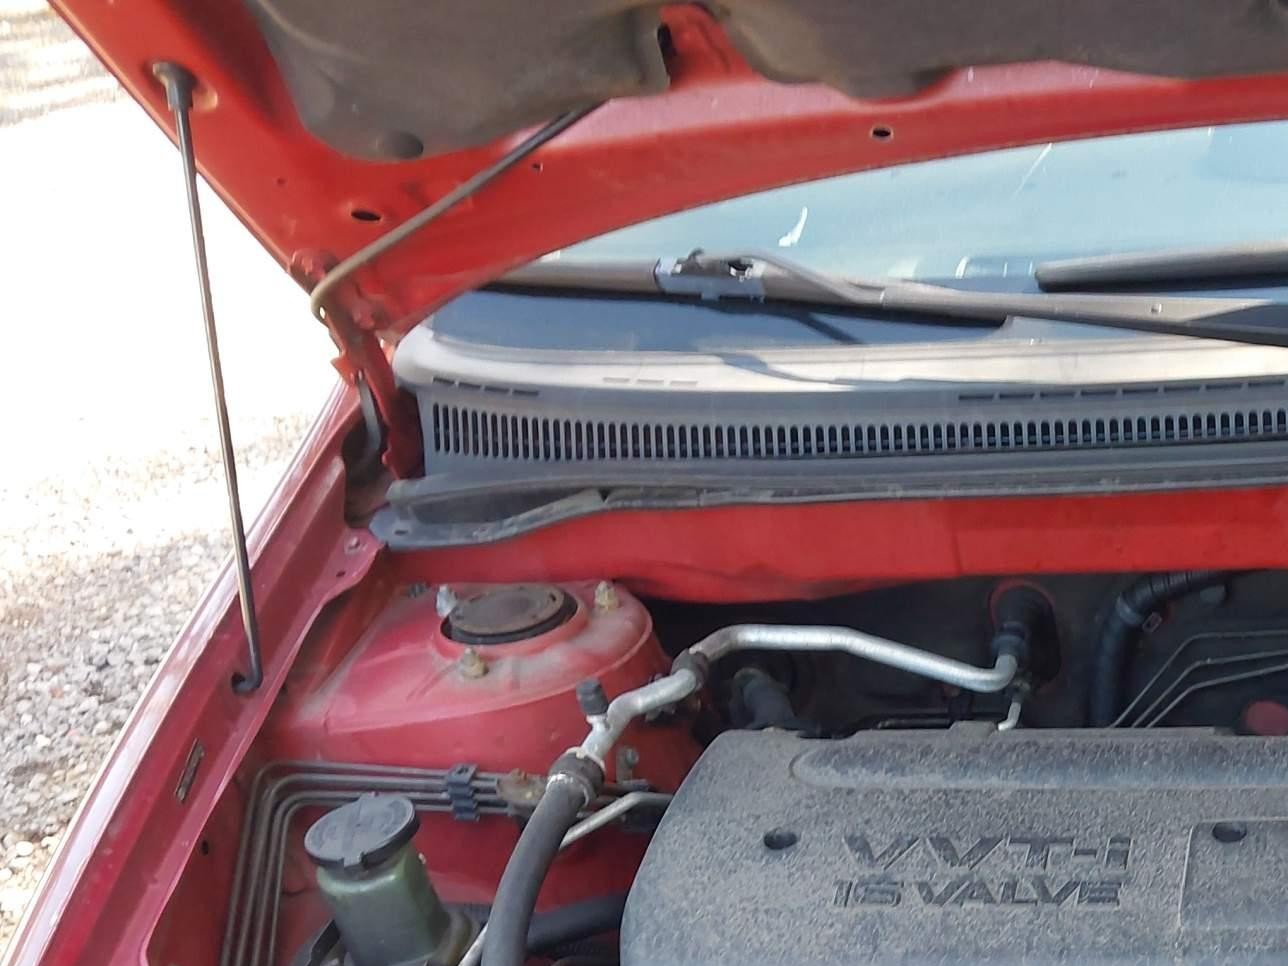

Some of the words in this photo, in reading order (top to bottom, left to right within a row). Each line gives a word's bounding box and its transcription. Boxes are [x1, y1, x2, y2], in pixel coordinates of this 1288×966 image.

[843, 835, 1133, 871] VVT-i
[832, 879, 904, 907] 16
[913, 879, 1122, 907] VALVE
